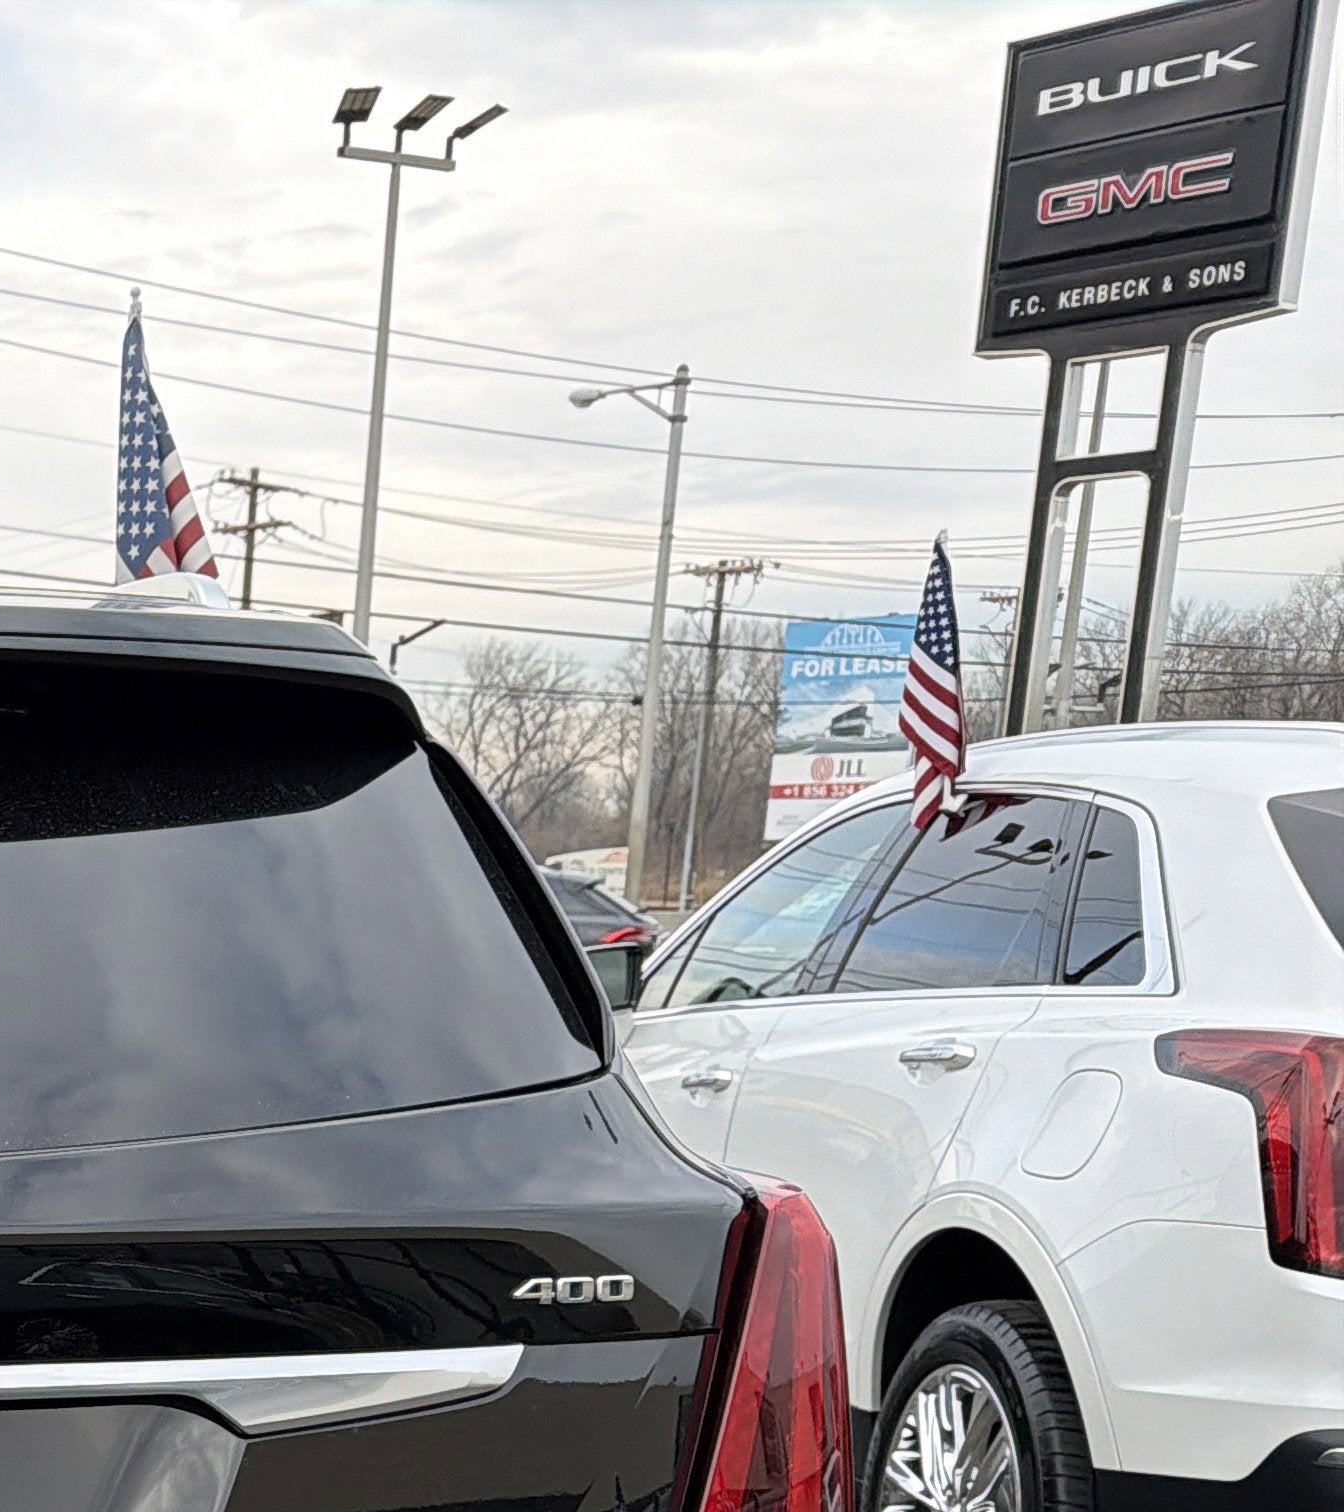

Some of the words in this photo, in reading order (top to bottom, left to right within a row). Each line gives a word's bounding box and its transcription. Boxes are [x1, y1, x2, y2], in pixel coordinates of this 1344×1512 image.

[1037, 42, 1259, 116] BUICK
[1037, 152, 1235, 225] GMC
[1009, 295, 1046, 318] F.C.
[1058, 277, 1151, 310] KERBECK
[1162, 275, 1173, 293] &
[1188, 260, 1246, 289] SONS
[791, 656, 835, 678] FOR
[840, 656, 909, 676] LEASE
[835, 758, 867, 778] JLL
[512, 1274, 635, 1305] 400
